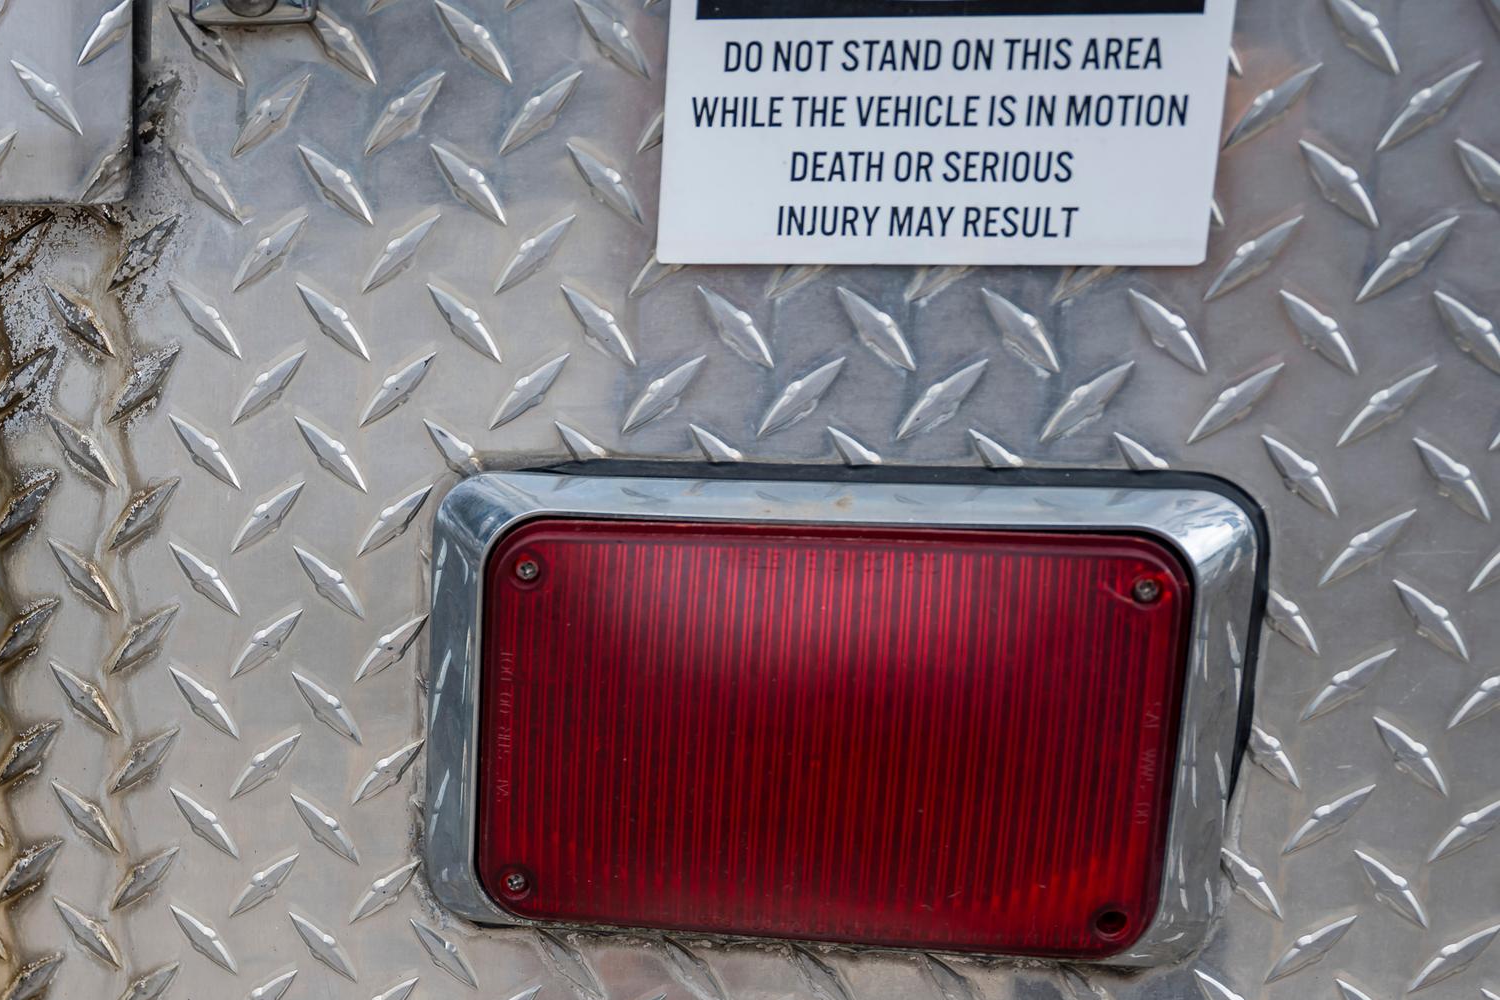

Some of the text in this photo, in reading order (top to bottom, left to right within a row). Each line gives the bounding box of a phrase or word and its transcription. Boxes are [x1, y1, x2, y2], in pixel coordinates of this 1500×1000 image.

[723, 36, 1163, 73] DO NOT STAND ON THIS AREA
[691, 94, 1189, 128] WHILE THE VEHICLE IS IN MOTION
[790, 150, 1074, 183] DEATH OR SERIOUS
[777, 205, 1080, 238] INJURY MAY RESULT
